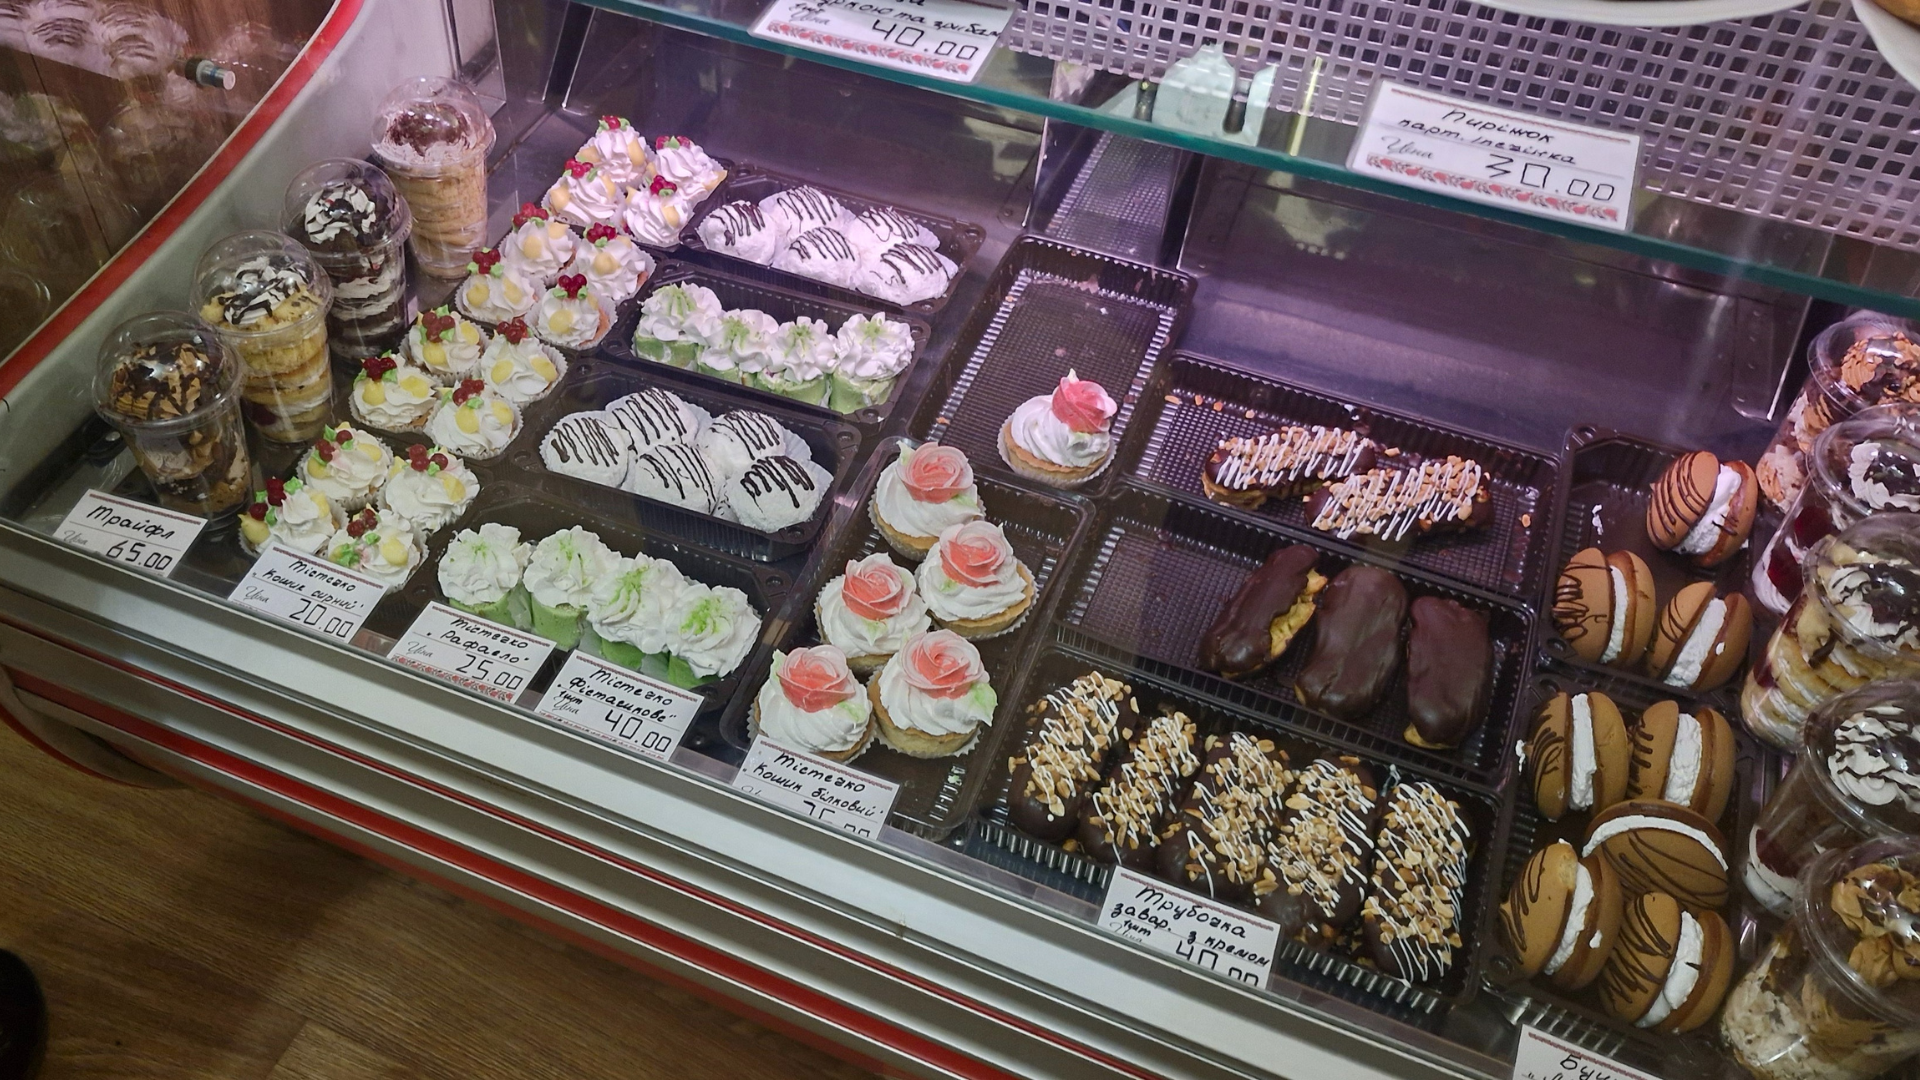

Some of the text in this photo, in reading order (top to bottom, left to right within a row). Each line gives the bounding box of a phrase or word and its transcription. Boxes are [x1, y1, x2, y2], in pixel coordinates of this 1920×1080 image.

[872, 18, 979, 61] 40.00
[1380, 135, 1434, 160] Ціна
[1484, 153, 1615, 201] 30.00
[63, 529, 89, 546] Ціна
[86, 505, 175, 539] Трайфл
[105, 540, 173, 571] 65.00
[243, 585, 269, 604] Ціна
[288, 560, 356, 592] Тістечко
[289, 598, 354, 638] 20.00
[449, 617, 529, 649] Тістечко
[406, 640, 434, 659] Ціна
[455, 654, 524, 691] 25.00
[588, 668, 673, 706] Тістечко
[605, 709, 672, 753] 40.00
[773, 752, 866, 793] Тістечко
[1135, 886, 1247, 938] Трубочка
[1110, 903, 1271, 967] завар. з кремом
